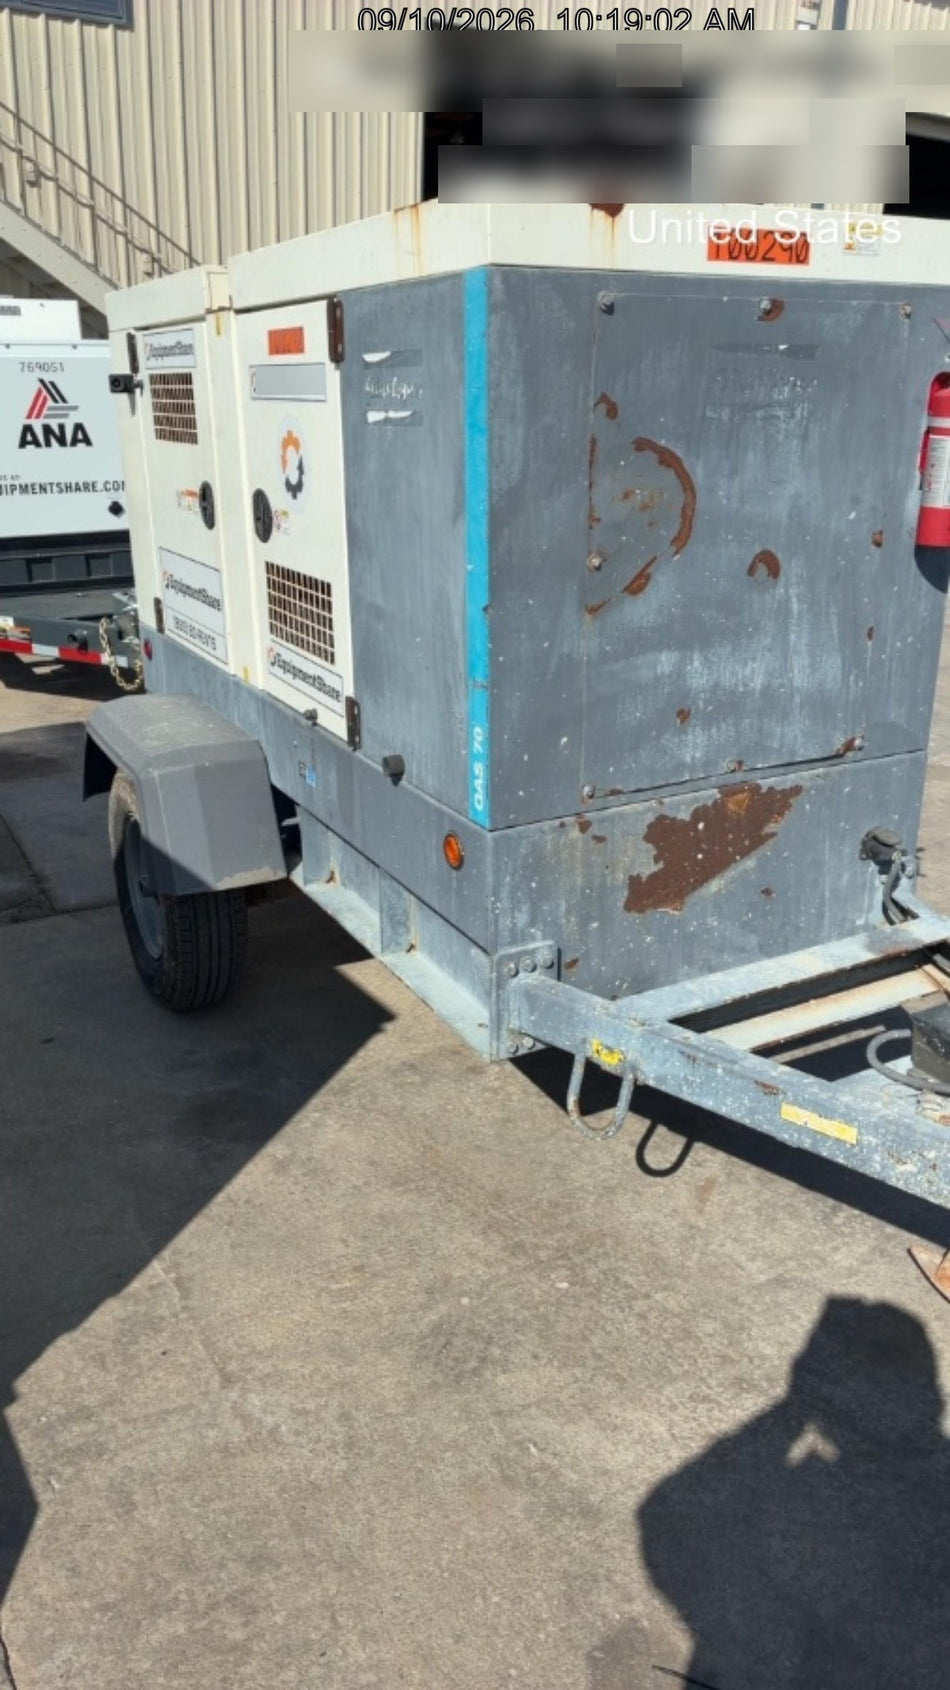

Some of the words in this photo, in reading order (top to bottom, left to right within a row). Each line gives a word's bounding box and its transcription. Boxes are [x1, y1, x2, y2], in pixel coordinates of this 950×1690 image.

[19, 361, 65, 372] 769051
[18, 421, 93, 449] ANA
[472, 725, 484, 753] 70
